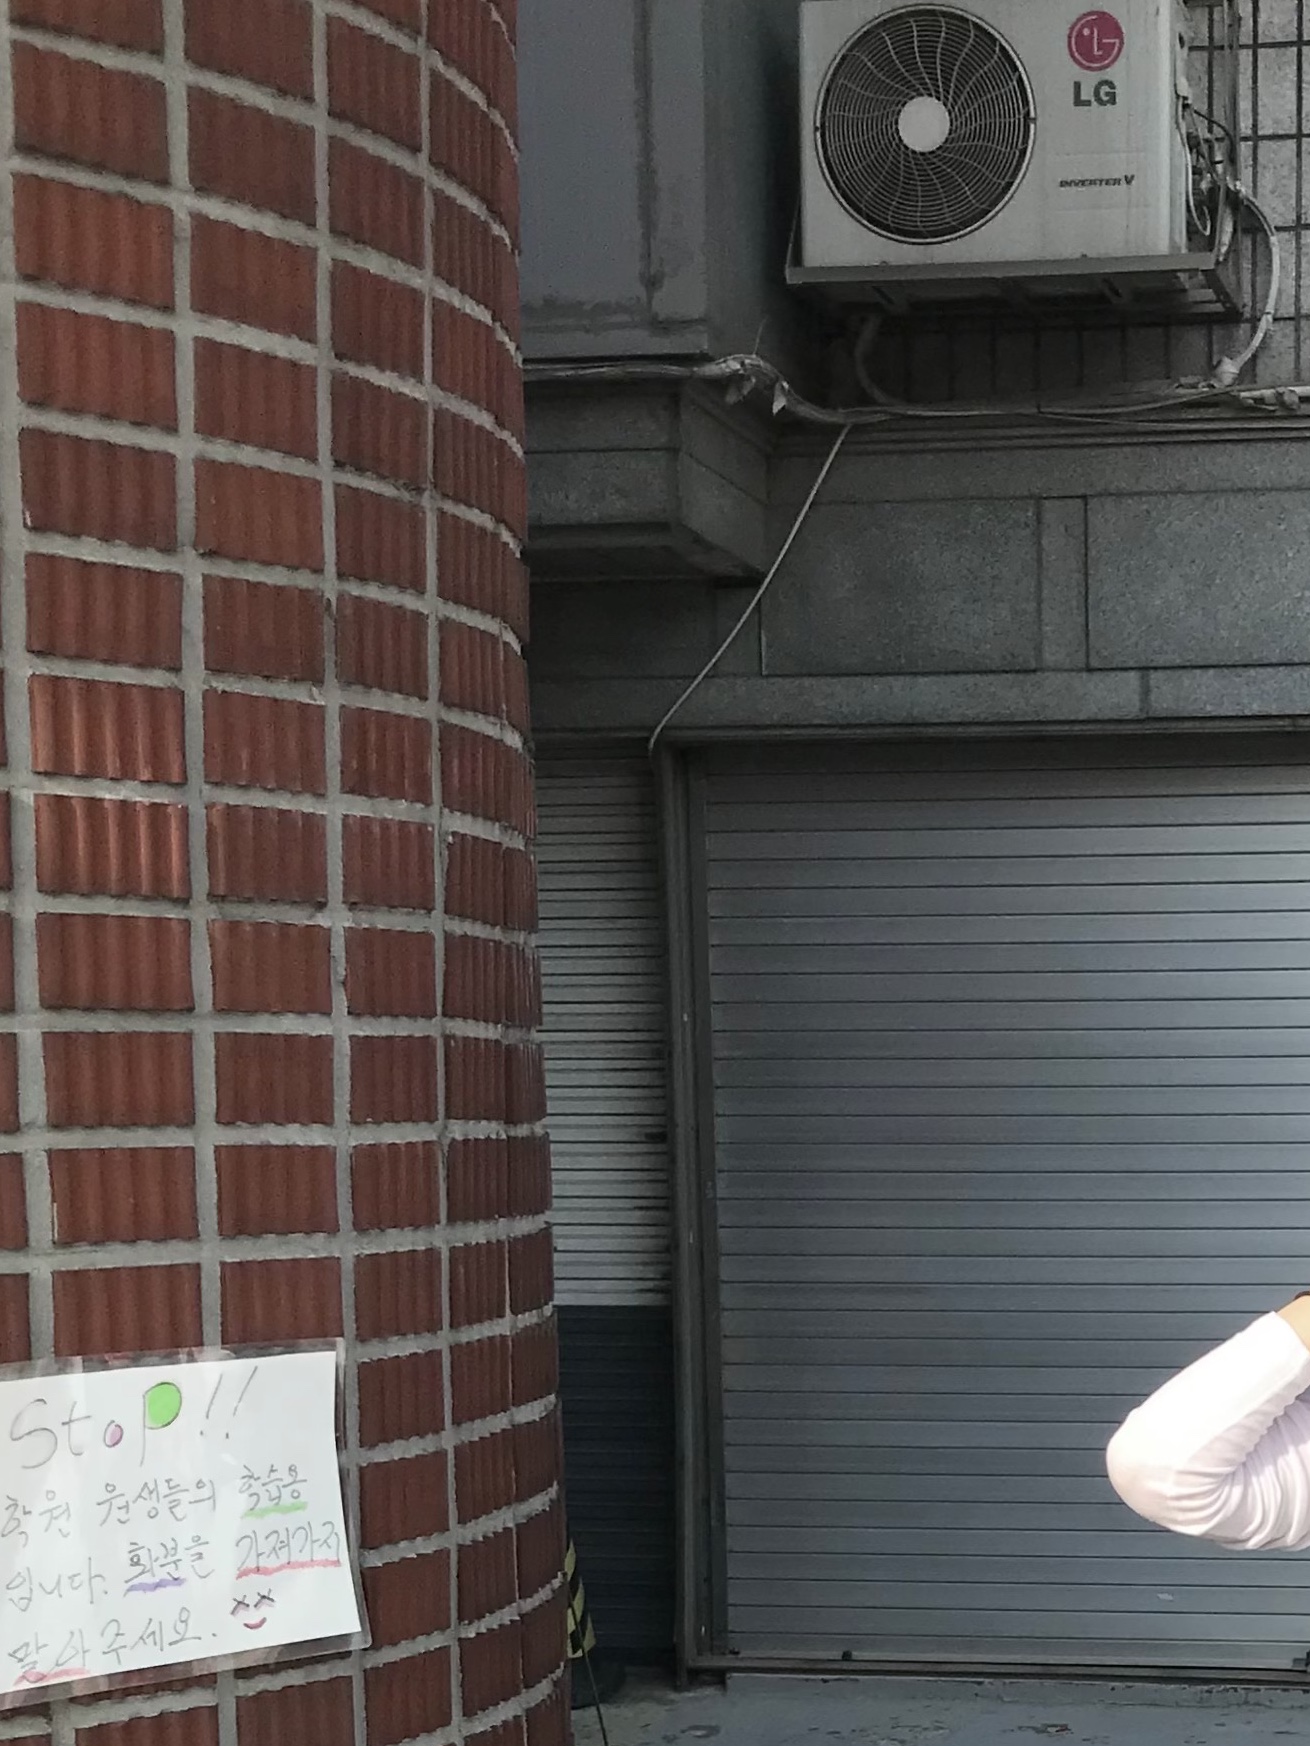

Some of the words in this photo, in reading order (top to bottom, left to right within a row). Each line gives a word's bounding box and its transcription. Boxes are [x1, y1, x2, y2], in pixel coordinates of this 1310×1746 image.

[1073, 79, 1117, 107] LG
[1124, 174, 1136, 185] V
[1, 1489, 71, 1547] 학원
[96, 1478, 217, 1527] 원생들의
[238, 1464, 308, 1512] 학습용
[5, 1557, 108, 1612] 입니다.
[124, 1534, 215, 1584] 화분을
[235, 1521, 341, 1573] 가져가지
